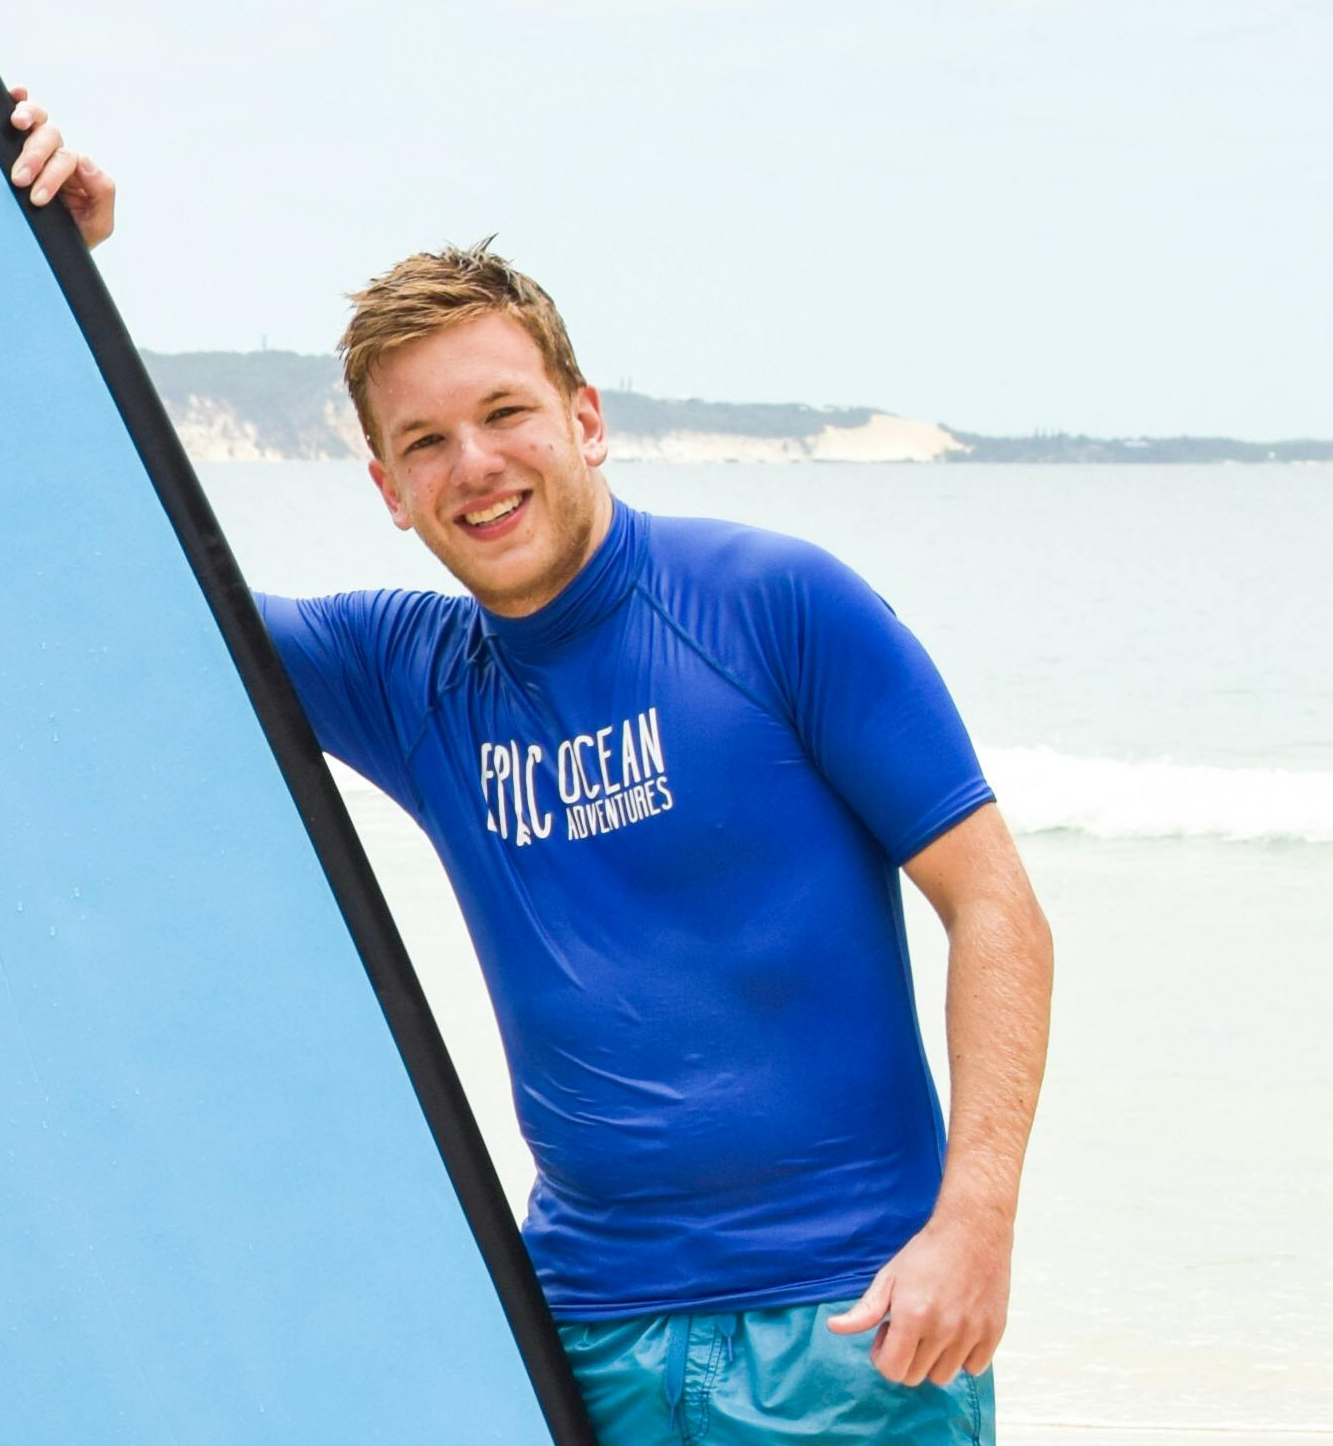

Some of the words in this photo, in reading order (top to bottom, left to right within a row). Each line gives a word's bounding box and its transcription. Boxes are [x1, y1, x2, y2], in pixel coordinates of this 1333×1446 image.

[481, 739, 552, 847] EPIC
[558, 707, 665, 805] OCEAN
[566, 775, 673, 841] ADVENTURES
